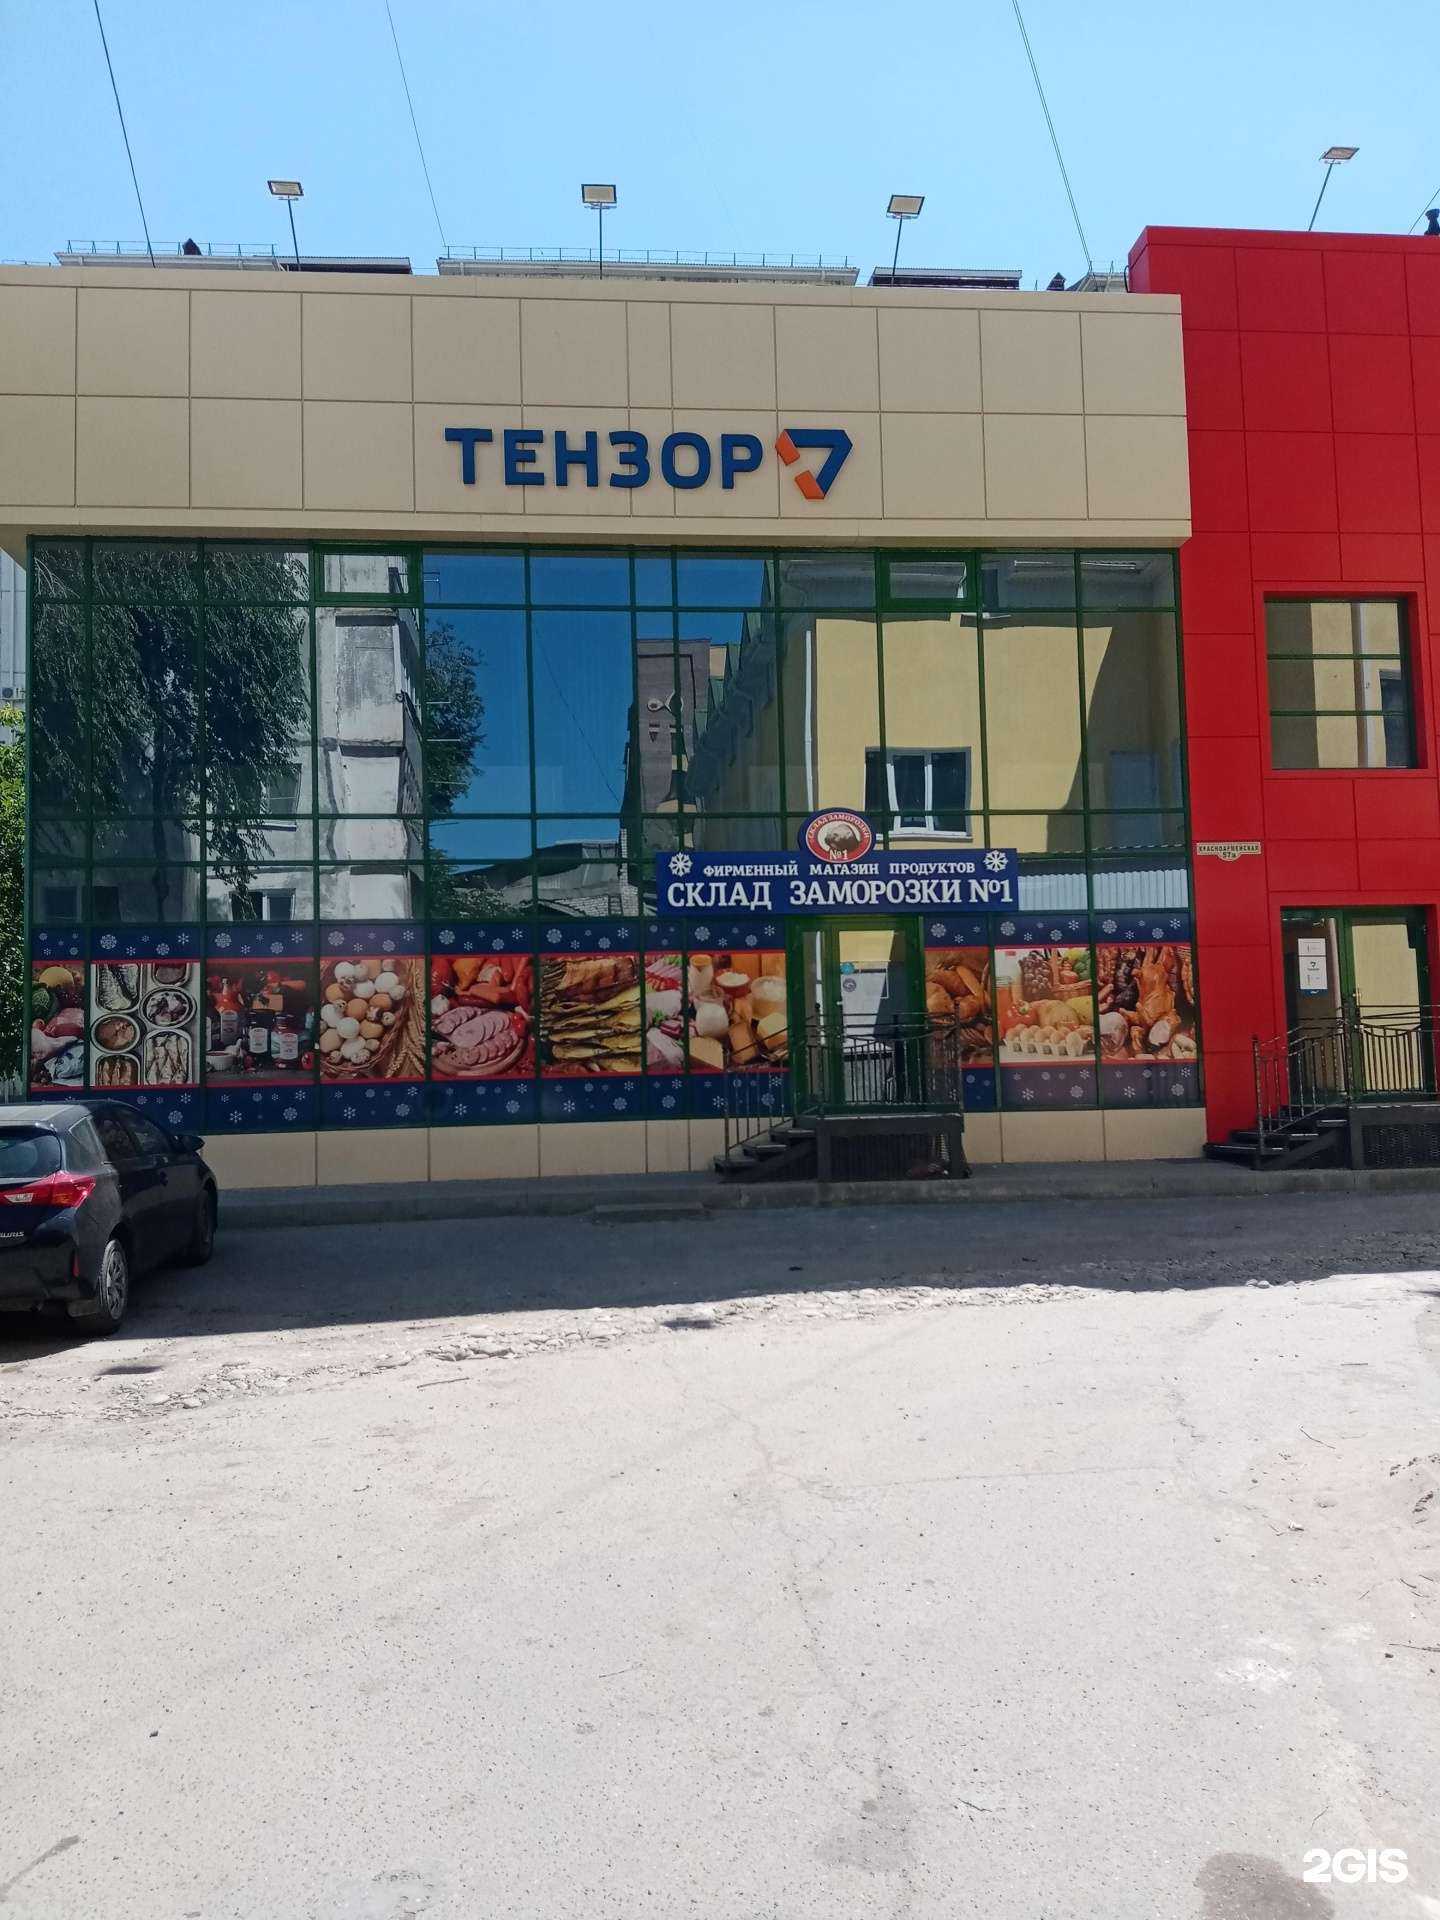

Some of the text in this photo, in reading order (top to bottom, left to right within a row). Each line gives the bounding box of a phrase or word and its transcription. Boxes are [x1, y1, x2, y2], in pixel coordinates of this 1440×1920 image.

[444, 427, 763, 490] ТЕНЗОР
[808, 813, 870, 839] СКЛАД ЗАМОРОЗКИ
[703, 860, 976, 877] ФИРМЕННЫЙ МАГАЗИН ПРОДУКТОВ
[667, 881, 772, 911] СКЛАД
[789, 879, 962, 906] ЗАМОРОЗКИ
